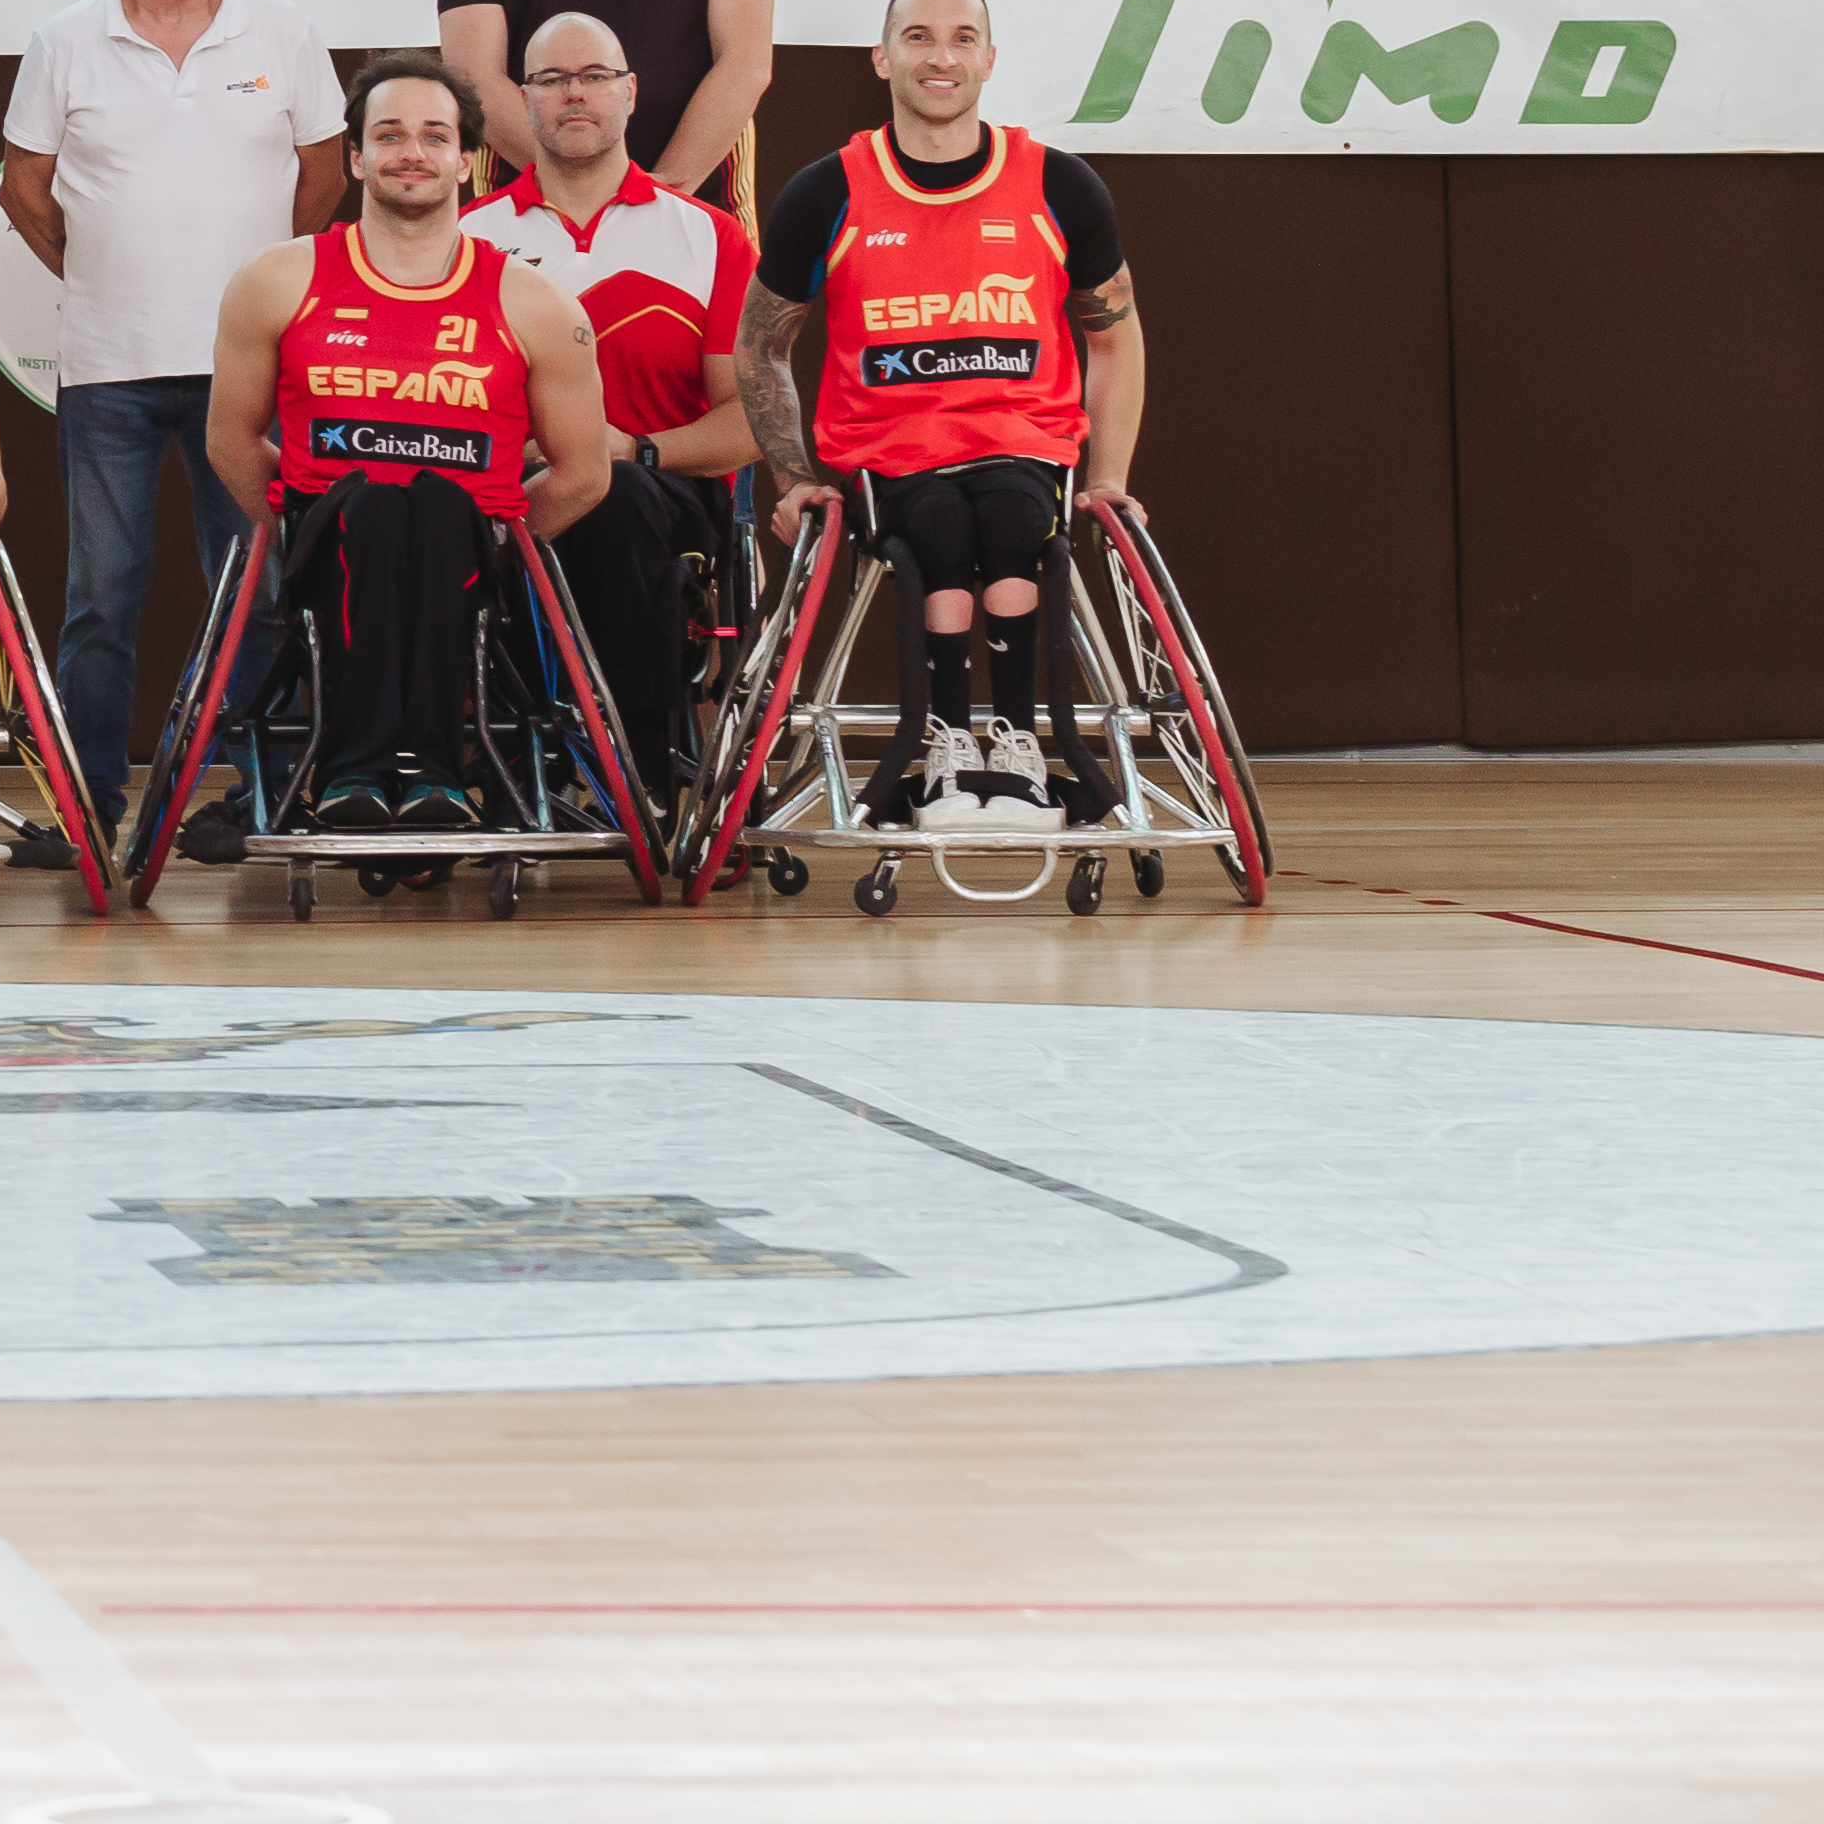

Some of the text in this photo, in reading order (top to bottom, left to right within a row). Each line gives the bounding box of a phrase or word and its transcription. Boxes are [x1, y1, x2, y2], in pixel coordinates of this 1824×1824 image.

[861, 272, 1037, 333] ESPAÑA
[434, 314, 479, 354] 21
[912, 345, 1033, 375] CaixaBank
[307, 359, 494, 412] ESPAÑA
[351, 427, 479, 466] CaixaBank
